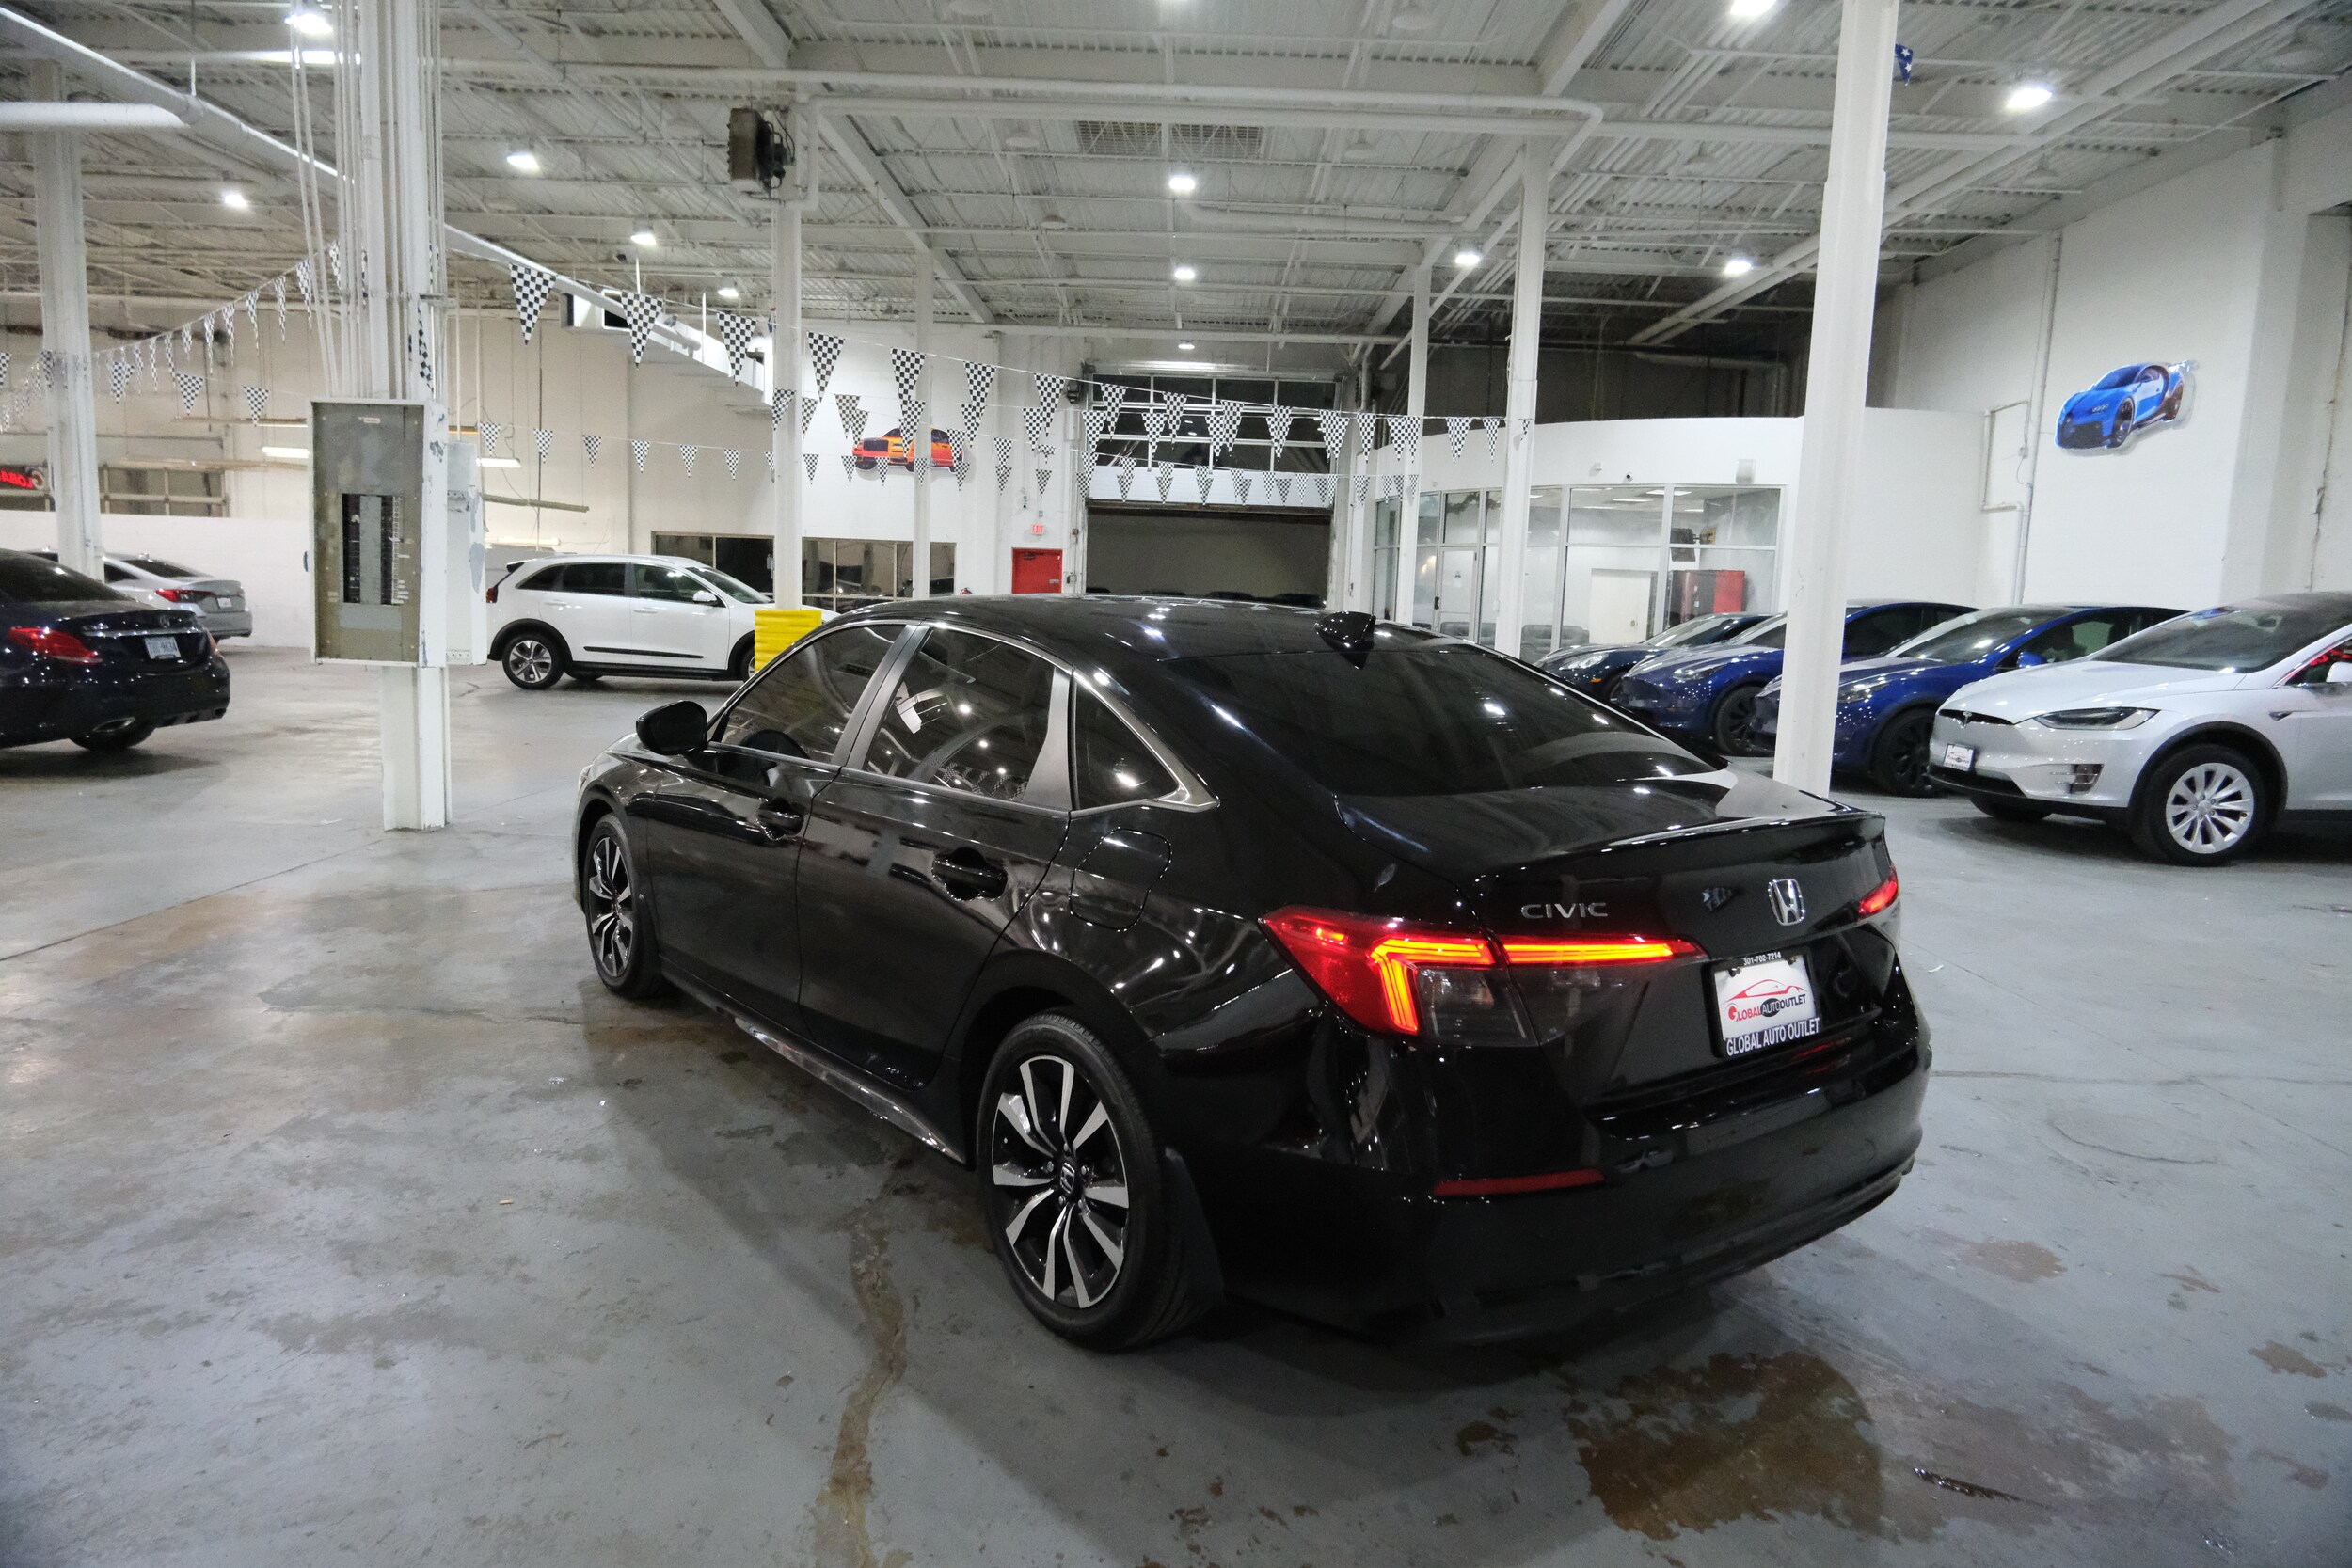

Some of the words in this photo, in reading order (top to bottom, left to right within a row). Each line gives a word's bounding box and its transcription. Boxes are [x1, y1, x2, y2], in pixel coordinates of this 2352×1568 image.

[1520, 902, 1608, 918] CIVIC
[1743, 951, 1782, 966] 301-702-7214
[1726, 1034, 1762, 1056] GLOBAL
[1762, 1025, 1787, 1047] AUTO
[1788, 1017, 1820, 1040] OUTLET
